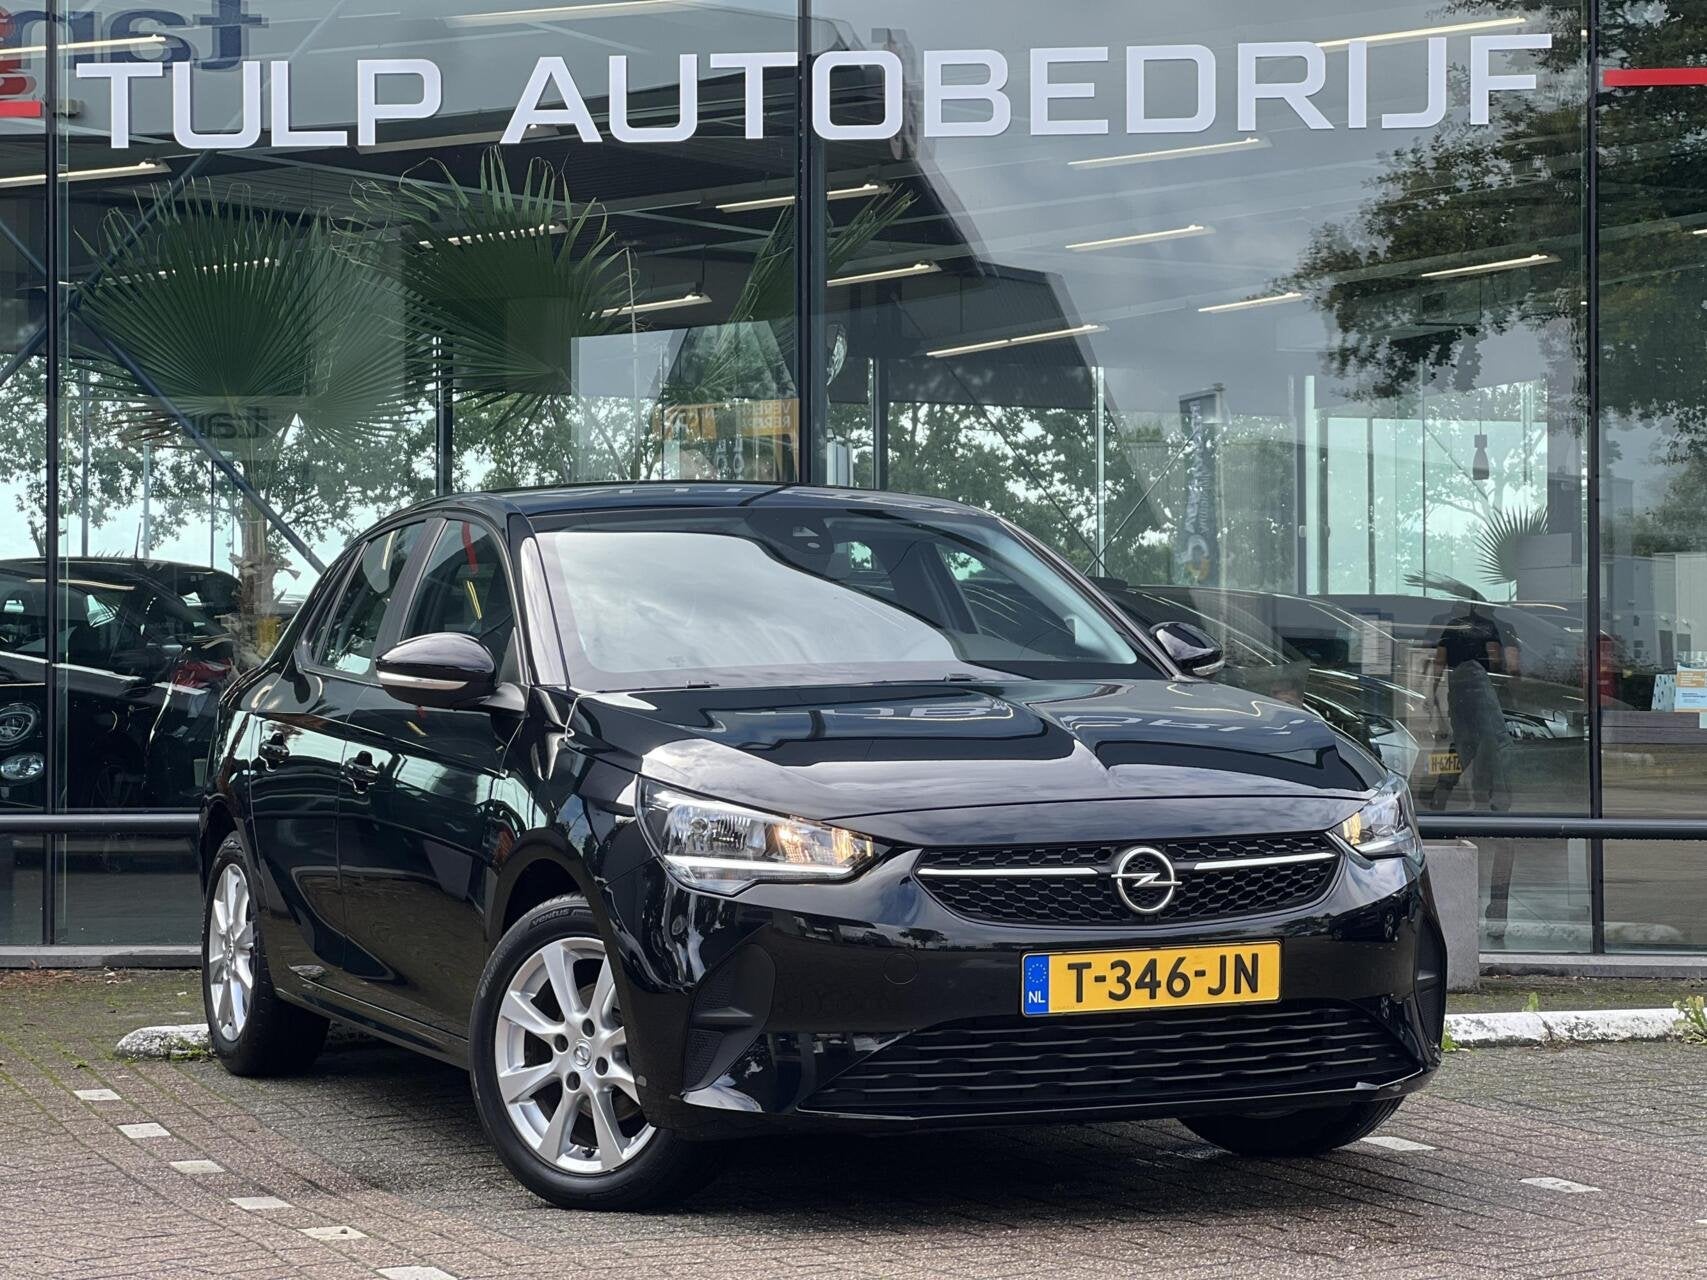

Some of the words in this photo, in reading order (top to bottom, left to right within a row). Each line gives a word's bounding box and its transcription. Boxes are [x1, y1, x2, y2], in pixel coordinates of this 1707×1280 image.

[76, 60, 442, 149] TULP
[500, 33, 1552, 144] AUTOBEDRIJF
[1028, 990, 1045, 1003] NL
[1067, 952, 1259, 1003] T-346-JN
